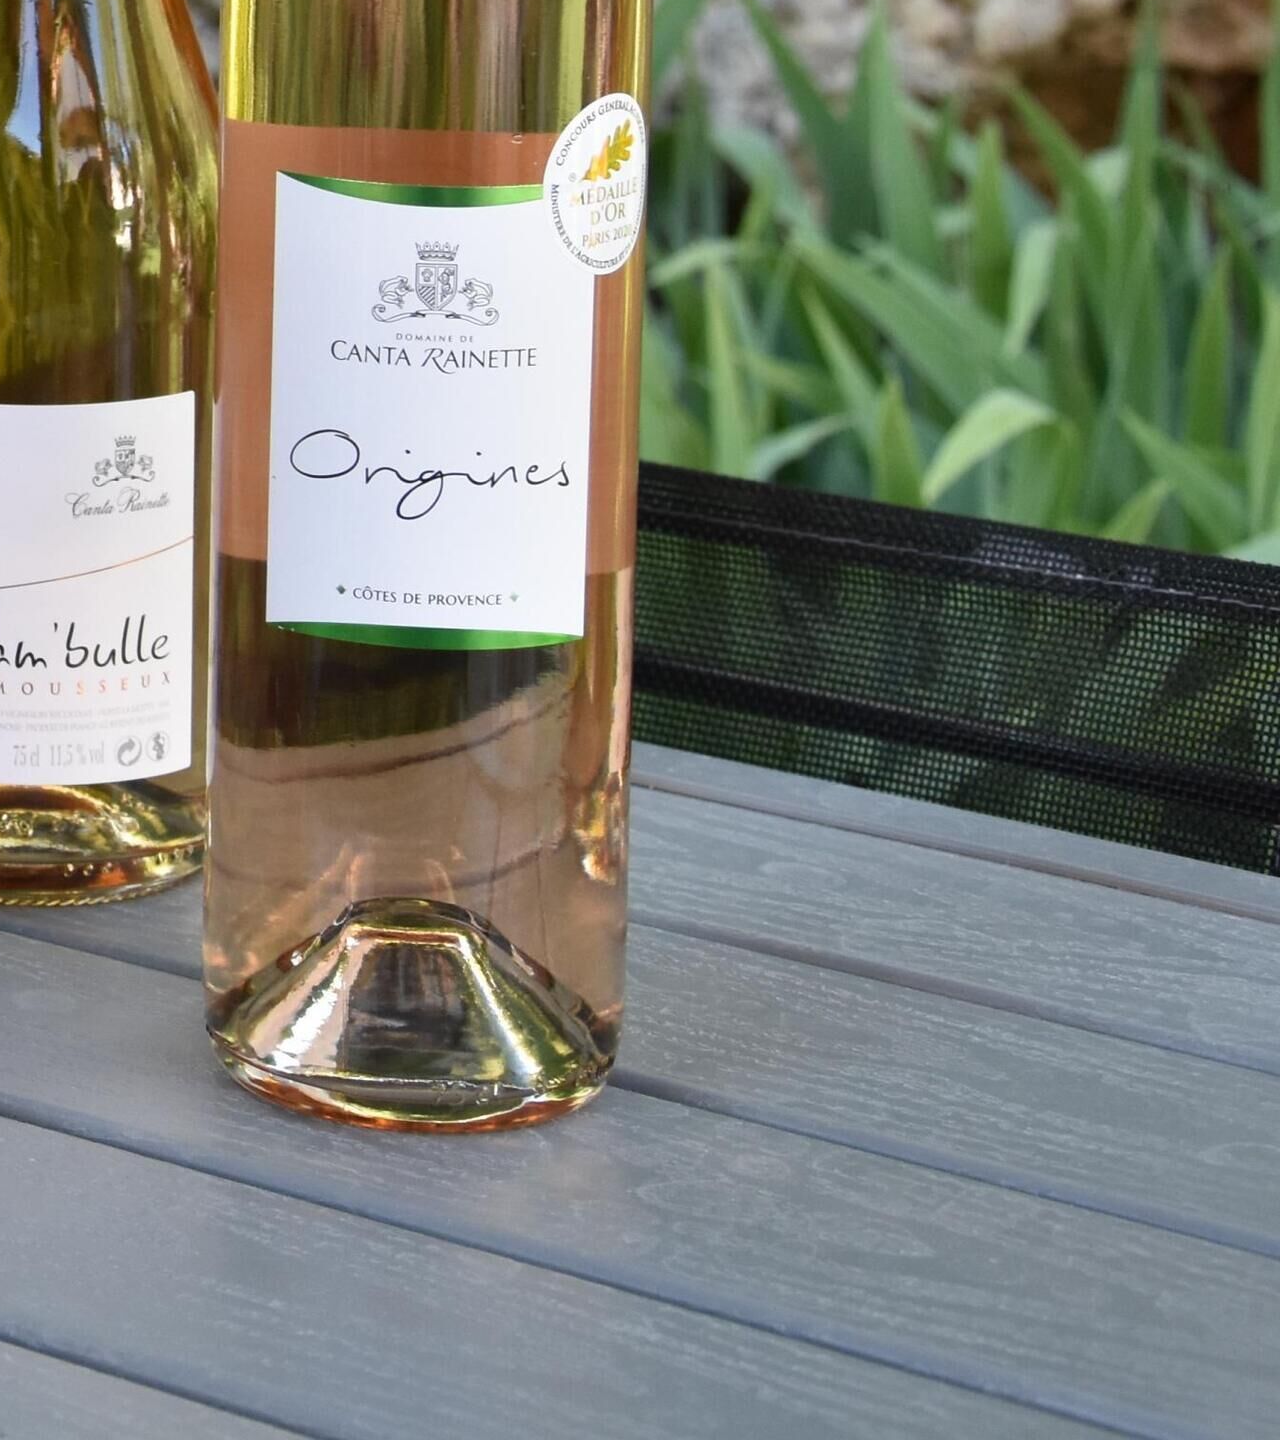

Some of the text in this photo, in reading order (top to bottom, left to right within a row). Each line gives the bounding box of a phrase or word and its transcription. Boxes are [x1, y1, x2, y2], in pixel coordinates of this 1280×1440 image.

[555, 111, 597, 167] CONCOURS
[590, 201, 626, 226] D'OR
[395, 333, 474, 344] DOMAINE DE
[331, 340, 537, 375] CANTA RAINETTE
[290, 429, 570, 520] Origines
[64, 486, 170, 519] Canta Rainette
[352, 585, 503, 607] CÔTES DE PROVENCE
